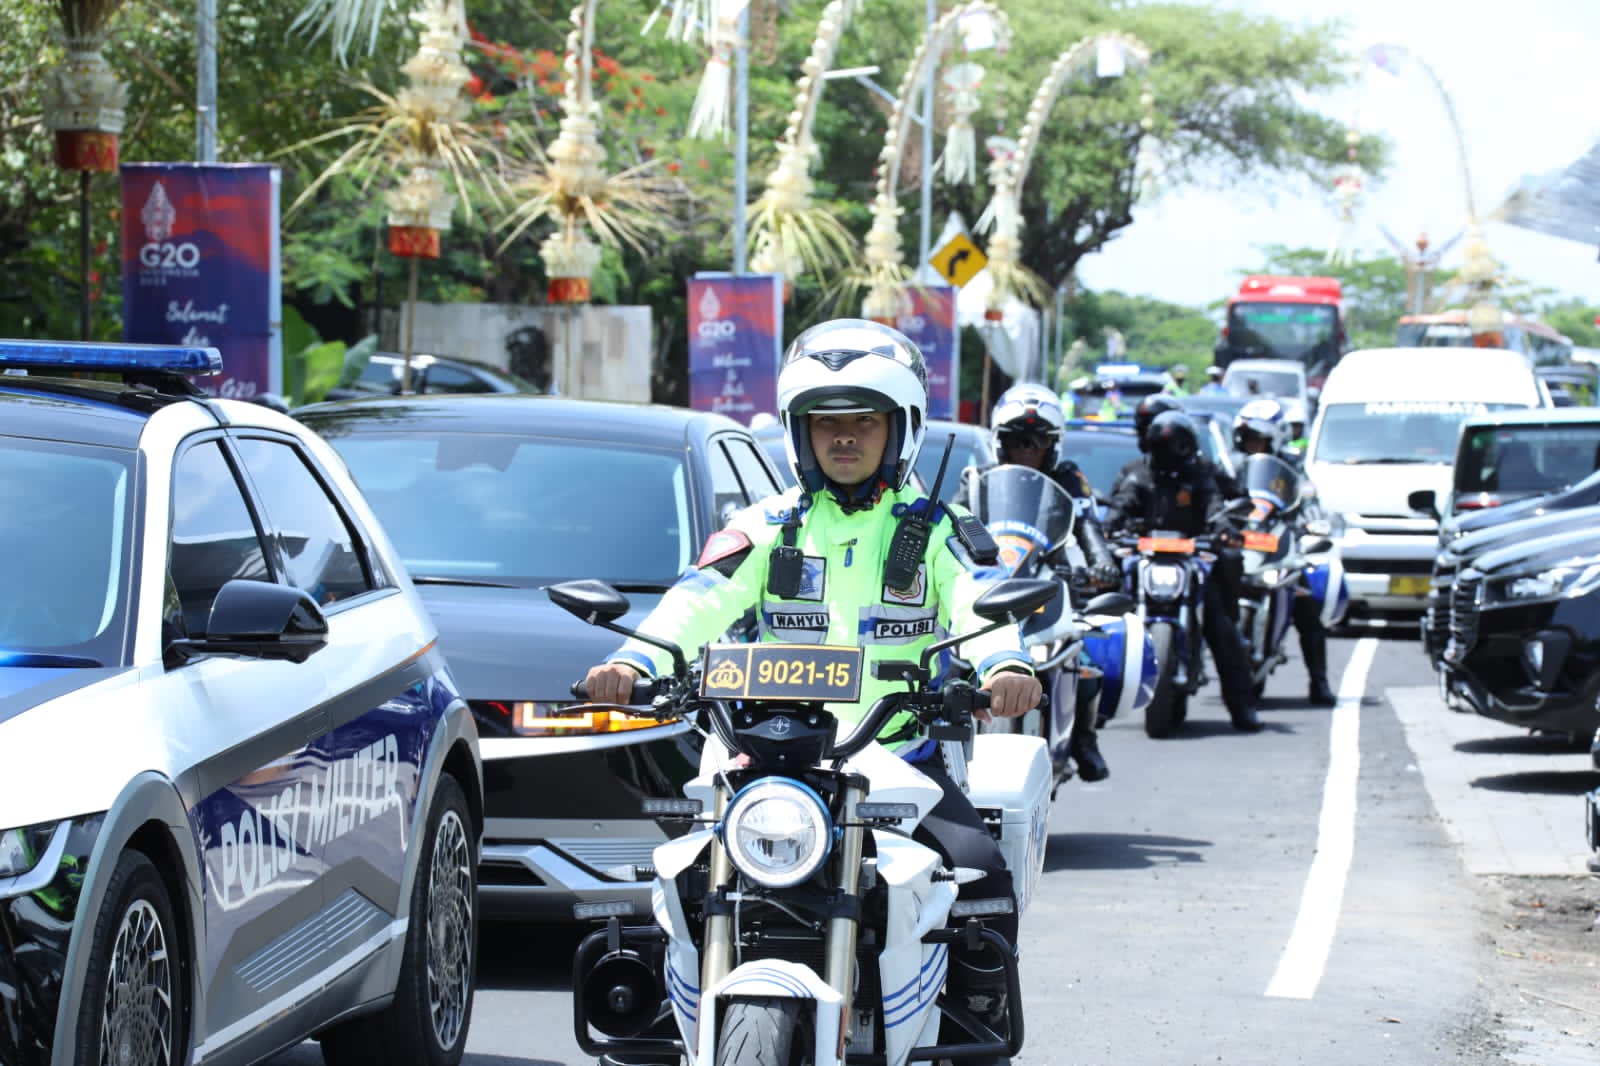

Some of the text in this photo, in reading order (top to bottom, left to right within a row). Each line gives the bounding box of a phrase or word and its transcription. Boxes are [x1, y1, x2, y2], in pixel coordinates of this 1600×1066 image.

[139, 242, 200, 268] G20
[776, 614, 825, 627] WAHYU
[879, 620, 929, 636] POLISI
[757, 659, 851, 688] 9021-15
[221, 733, 400, 901] POLISI MILITER
